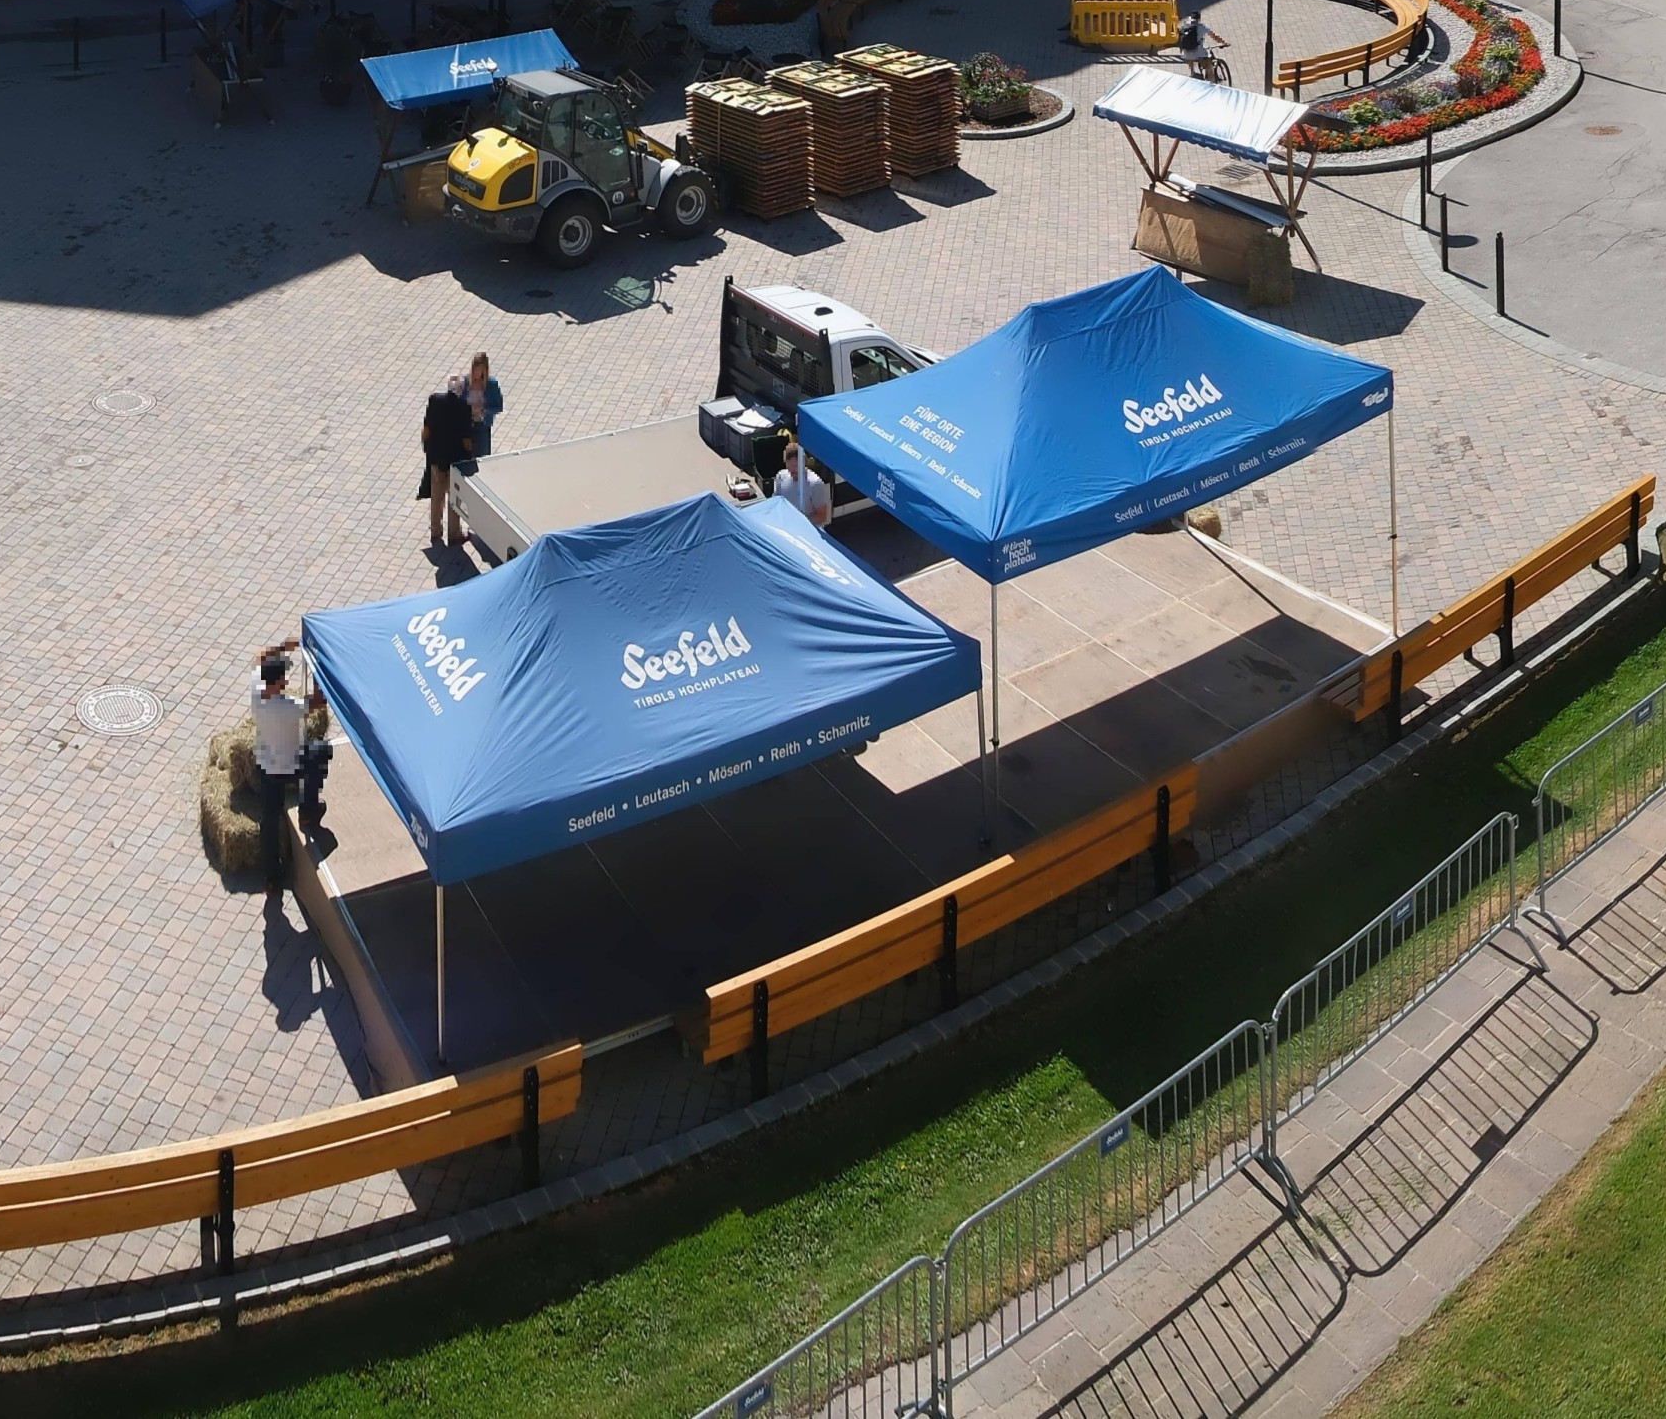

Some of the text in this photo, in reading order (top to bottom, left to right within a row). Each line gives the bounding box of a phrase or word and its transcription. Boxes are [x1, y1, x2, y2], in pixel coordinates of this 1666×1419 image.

[912, 404, 965, 442] FÜNF ORTE
[1123, 373, 1224, 436] Seefeld
[1138, 407, 1233, 448] TIROLS HOCHPLATEAU
[898, 413, 958, 455] EINE REGION
[1114, 435, 1307, 524] Seefeld Leutasch Mösern Reith Scharnitz
[1001, 538, 1033, 558] #tirols
[1004, 552, 1037, 574] plateau
[1008, 546, 1030, 563] hoch
[390, 633, 445, 717] TIROLS HOCHPLATEAU
[406, 607, 487, 703] Seefeld
[619, 615, 753, 691] Seefeld
[633, 663, 761, 710] TIROLS HOCHPLATEAU
[567, 714, 871, 833] Seefeld Leutasch Mösern Reith Scharnitz
